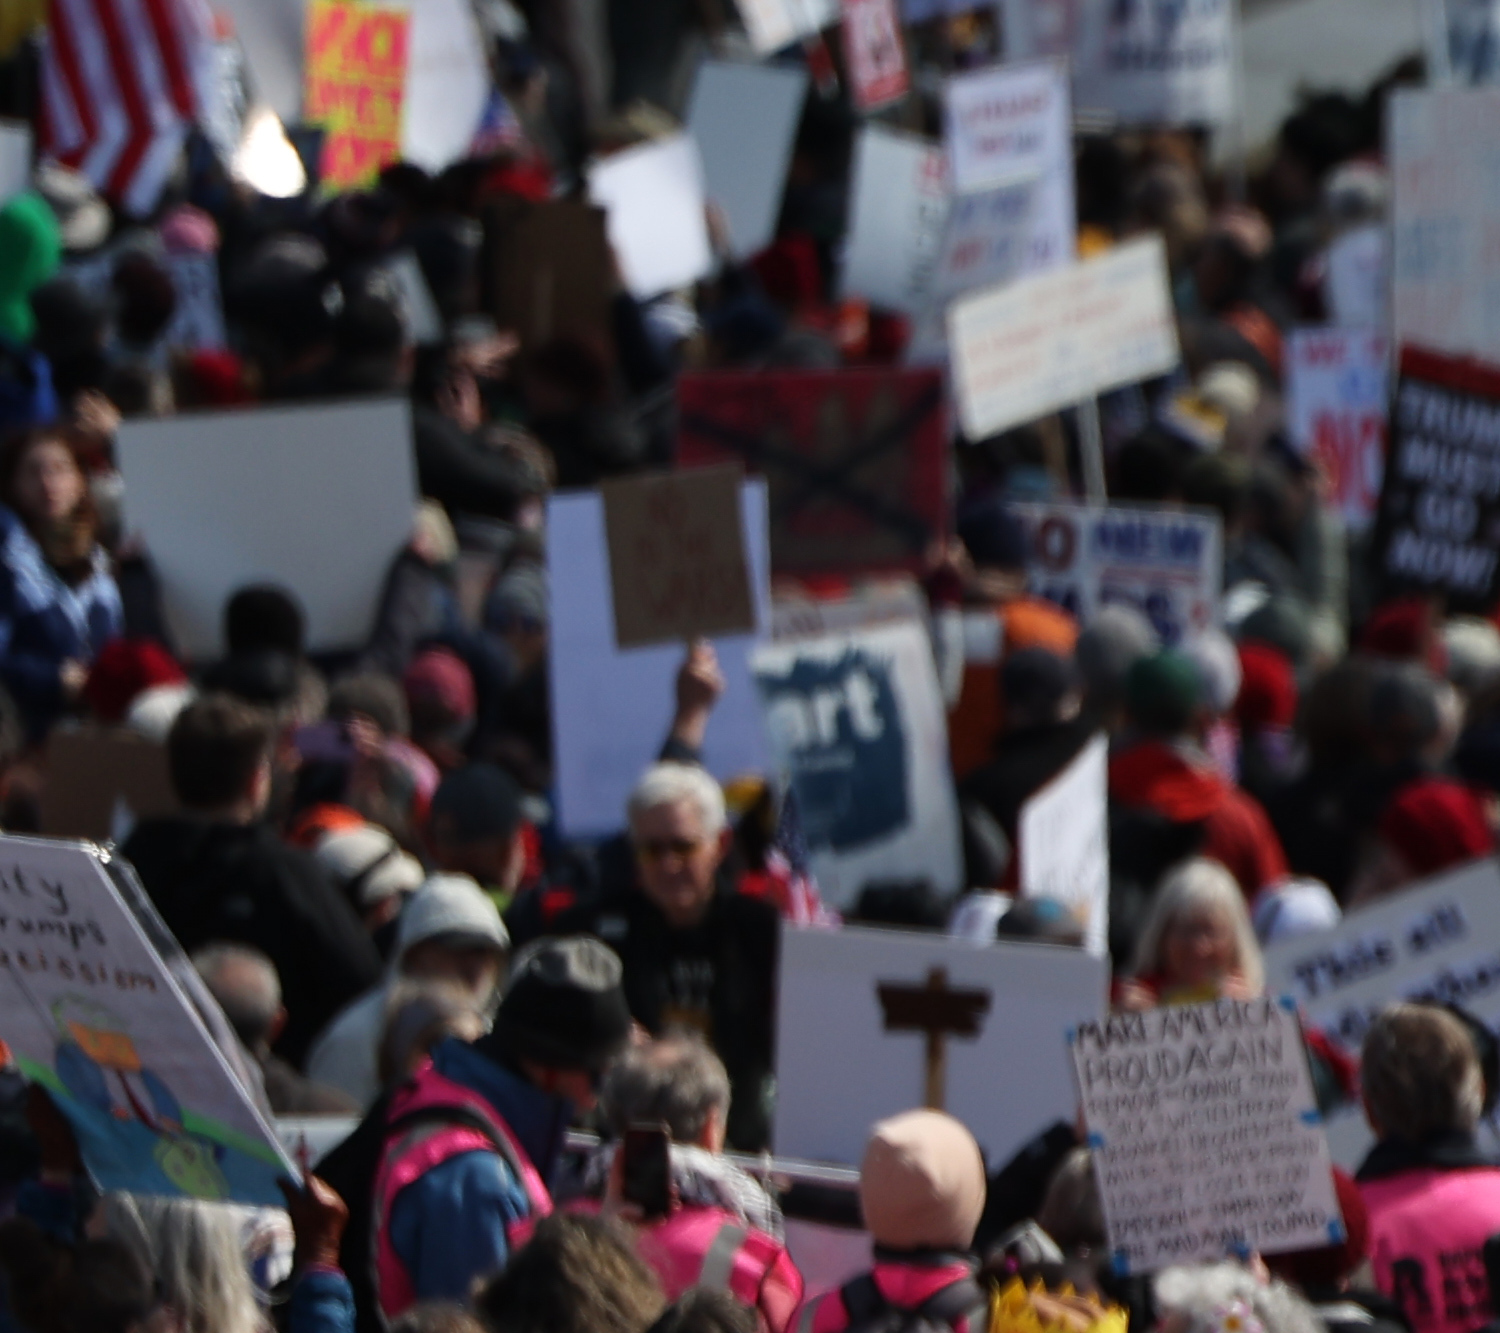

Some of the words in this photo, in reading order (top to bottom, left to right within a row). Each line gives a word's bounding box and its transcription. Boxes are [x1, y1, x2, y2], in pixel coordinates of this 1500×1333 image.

[1077, 1012, 1147, 1054] MAKE
[1160, 1000, 1284, 1042] AMERICA
[1085, 1047, 1181, 1089] PROUD
[1184, 1035, 1284, 1077] AGAIN
